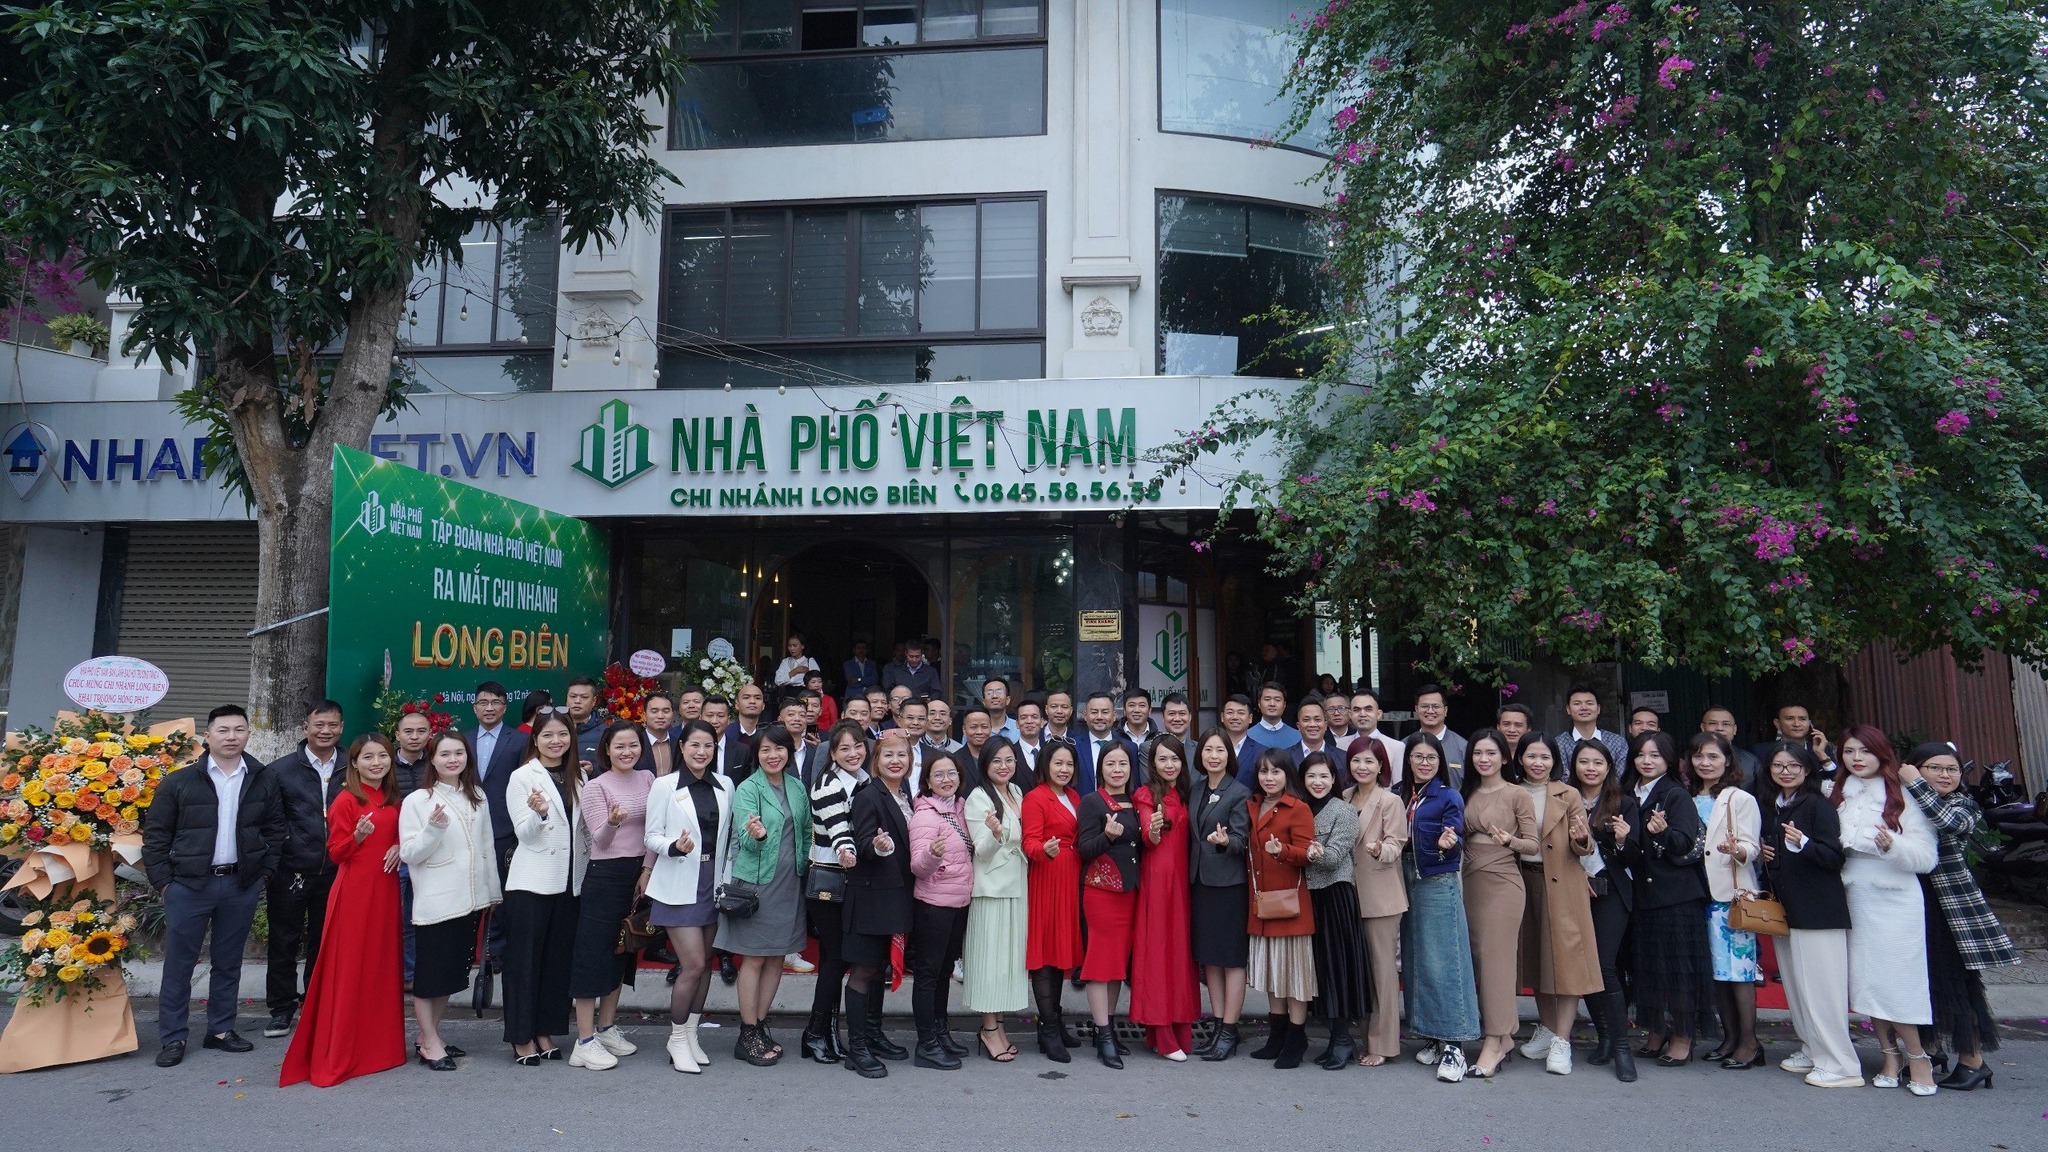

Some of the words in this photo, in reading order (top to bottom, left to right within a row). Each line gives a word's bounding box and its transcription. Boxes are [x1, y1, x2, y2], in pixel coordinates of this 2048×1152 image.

[671, 404, 766, 472] NHÀ
[790, 392, 890, 471] PHỐ
[898, 396, 1004, 480] VIỆT
[1028, 408, 1136, 467] NAM
[671, 488, 711, 507] CHI
[719, 482, 802, 507] NHÁNH
[812, 486, 878, 505] LONG
[887, 478, 937, 505] BIÊN
[973, 481, 1162, 502] 0845.58.56.58
[390, 502, 407, 521] NHÀ
[407, 506, 424, 524] PHỐ
[390, 519, 406, 537] VIỆT
[407, 524, 422, 539] NAM
[431, 517, 452, 545] TẬP
[454, 524, 482, 552] ĐOÀN
[484, 532, 504, 558] NHÀ
[506, 535, 525, 560] PHỐ
[526, 540, 543, 567] VIỆT
[545, 548, 562, 568] NAM
[433, 567, 454, 601] RA
[458, 563, 490, 606] MẮT
[493, 577, 514, 608] CHI
[518, 579, 558, 614] NHÁNH
[412, 621, 504, 669] LONG
[509, 622, 569, 670] BIÊN
[136, 682, 151, 691] LONG
[514, 690, 520, 700] 12
[521, 691, 531, 700] nă
